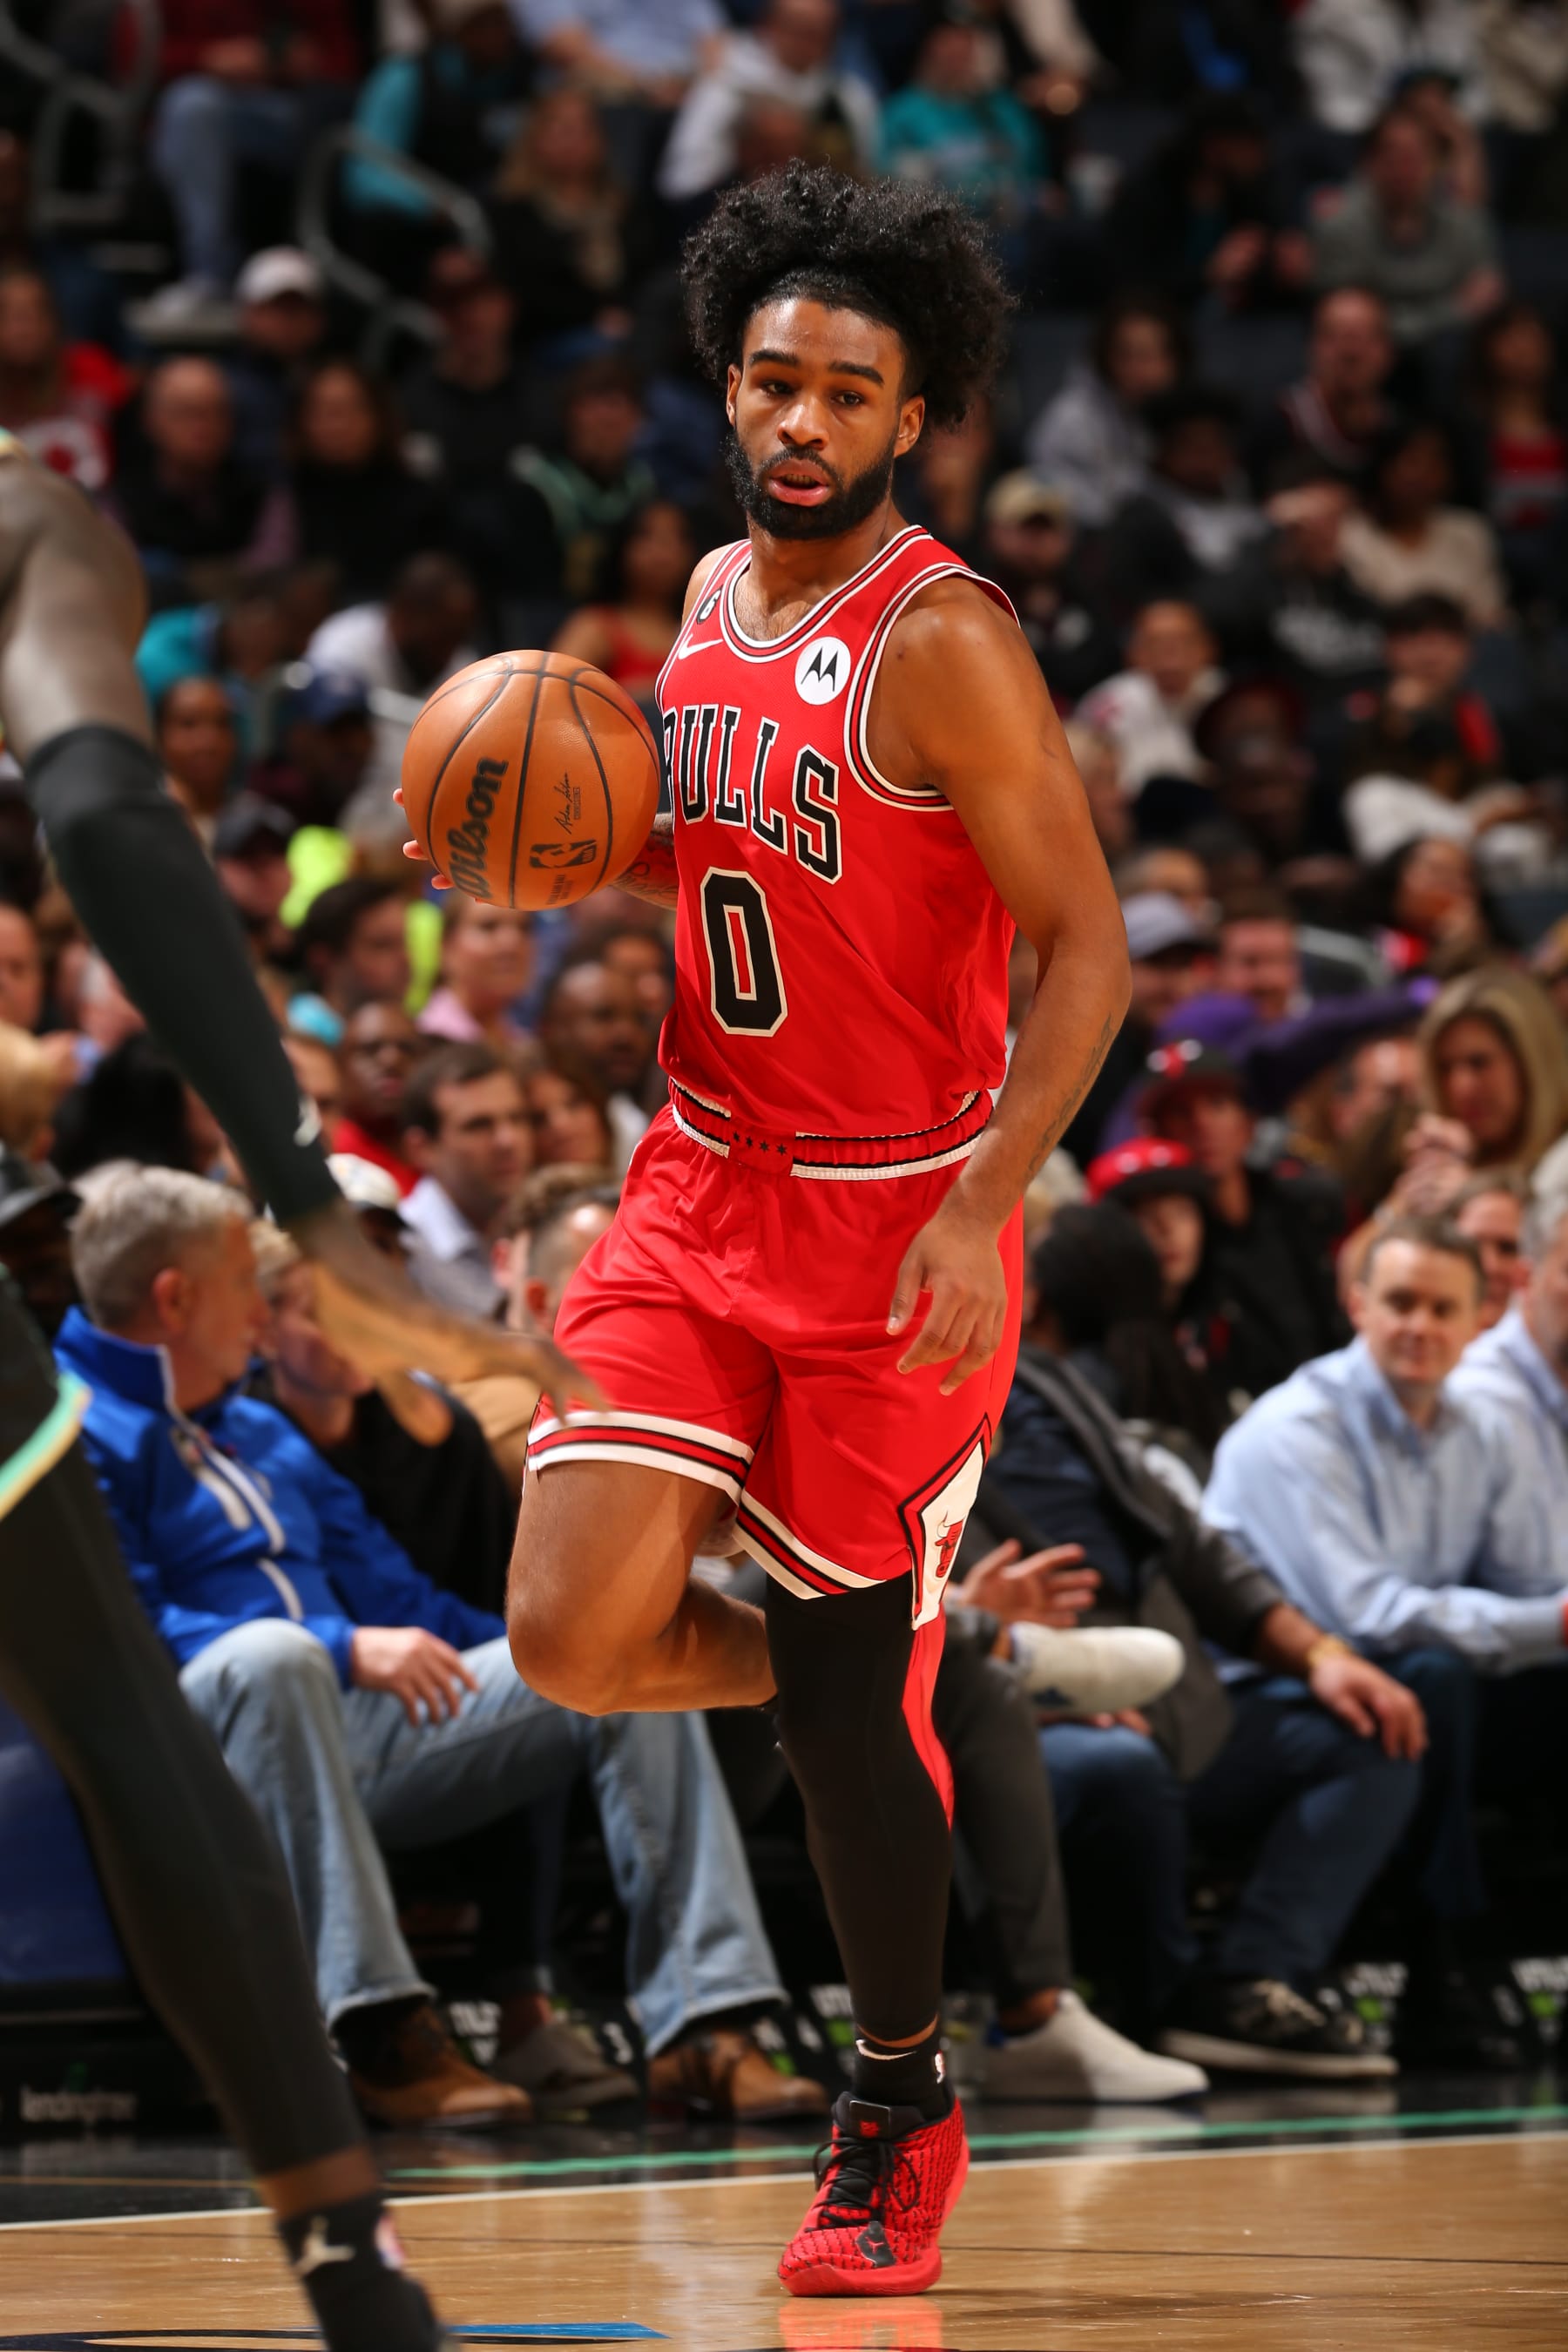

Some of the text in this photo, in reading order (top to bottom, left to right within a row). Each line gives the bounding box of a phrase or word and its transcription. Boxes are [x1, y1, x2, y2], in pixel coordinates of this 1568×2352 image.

[700, 589, 721, 620] 6
[448, 758, 509, 899] Wilson
[700, 867, 787, 1037] 0
